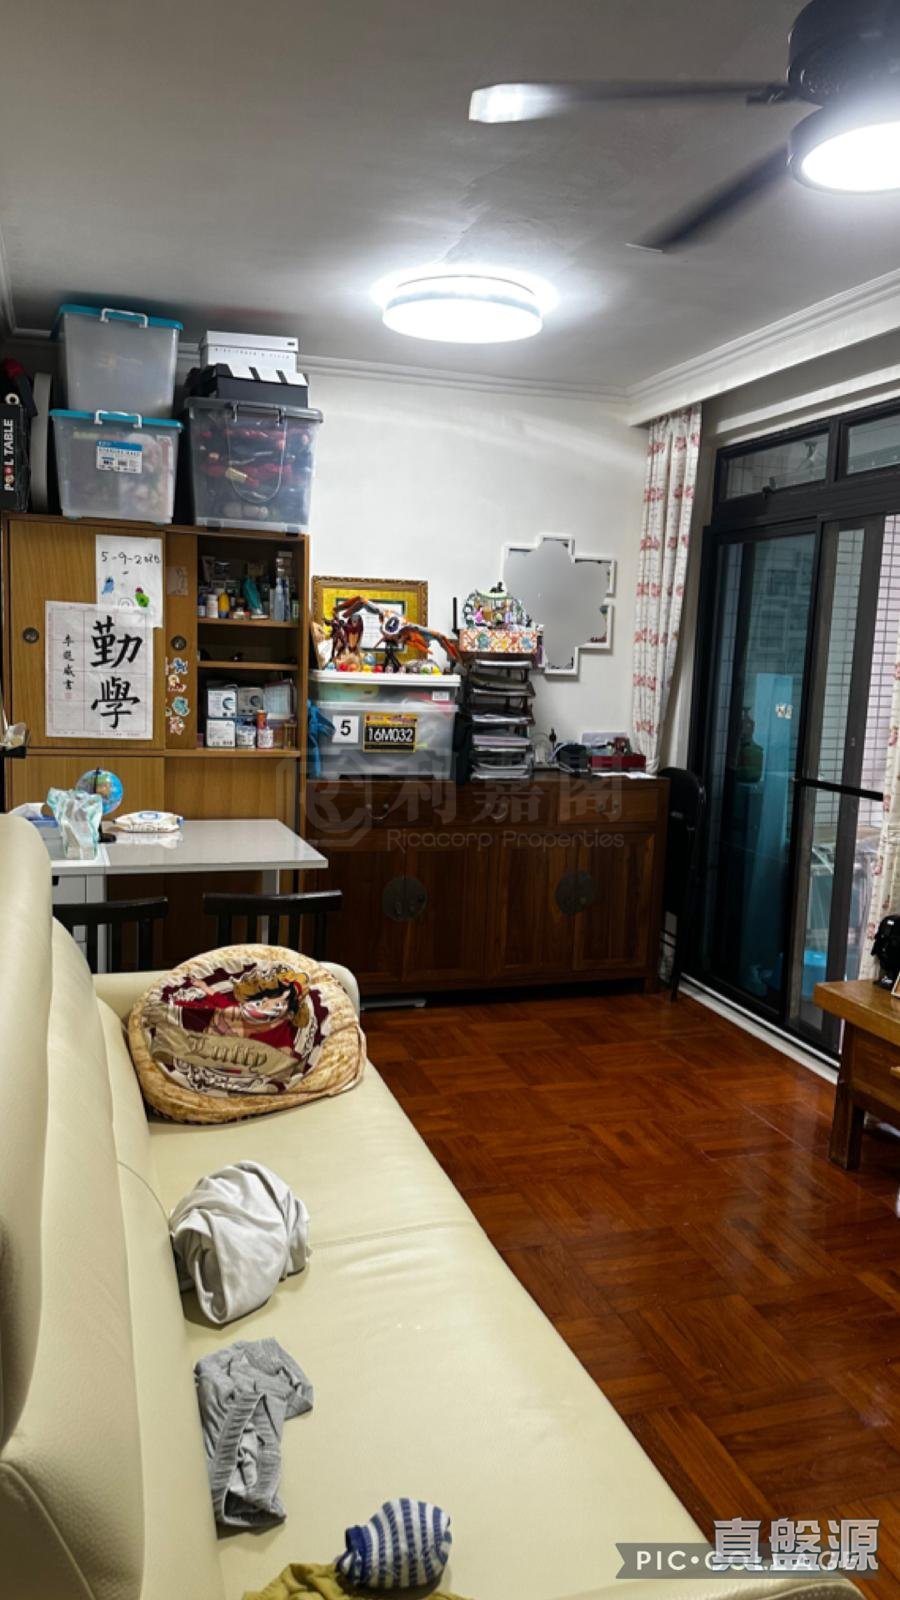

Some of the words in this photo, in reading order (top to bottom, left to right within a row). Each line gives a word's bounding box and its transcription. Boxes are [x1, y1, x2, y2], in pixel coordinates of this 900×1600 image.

[3, 418, 14, 456] TABLE
[90, 614, 143, 730] 勤學
[340, 719, 352, 736] 5
[368, 727, 413, 743] 16M032
